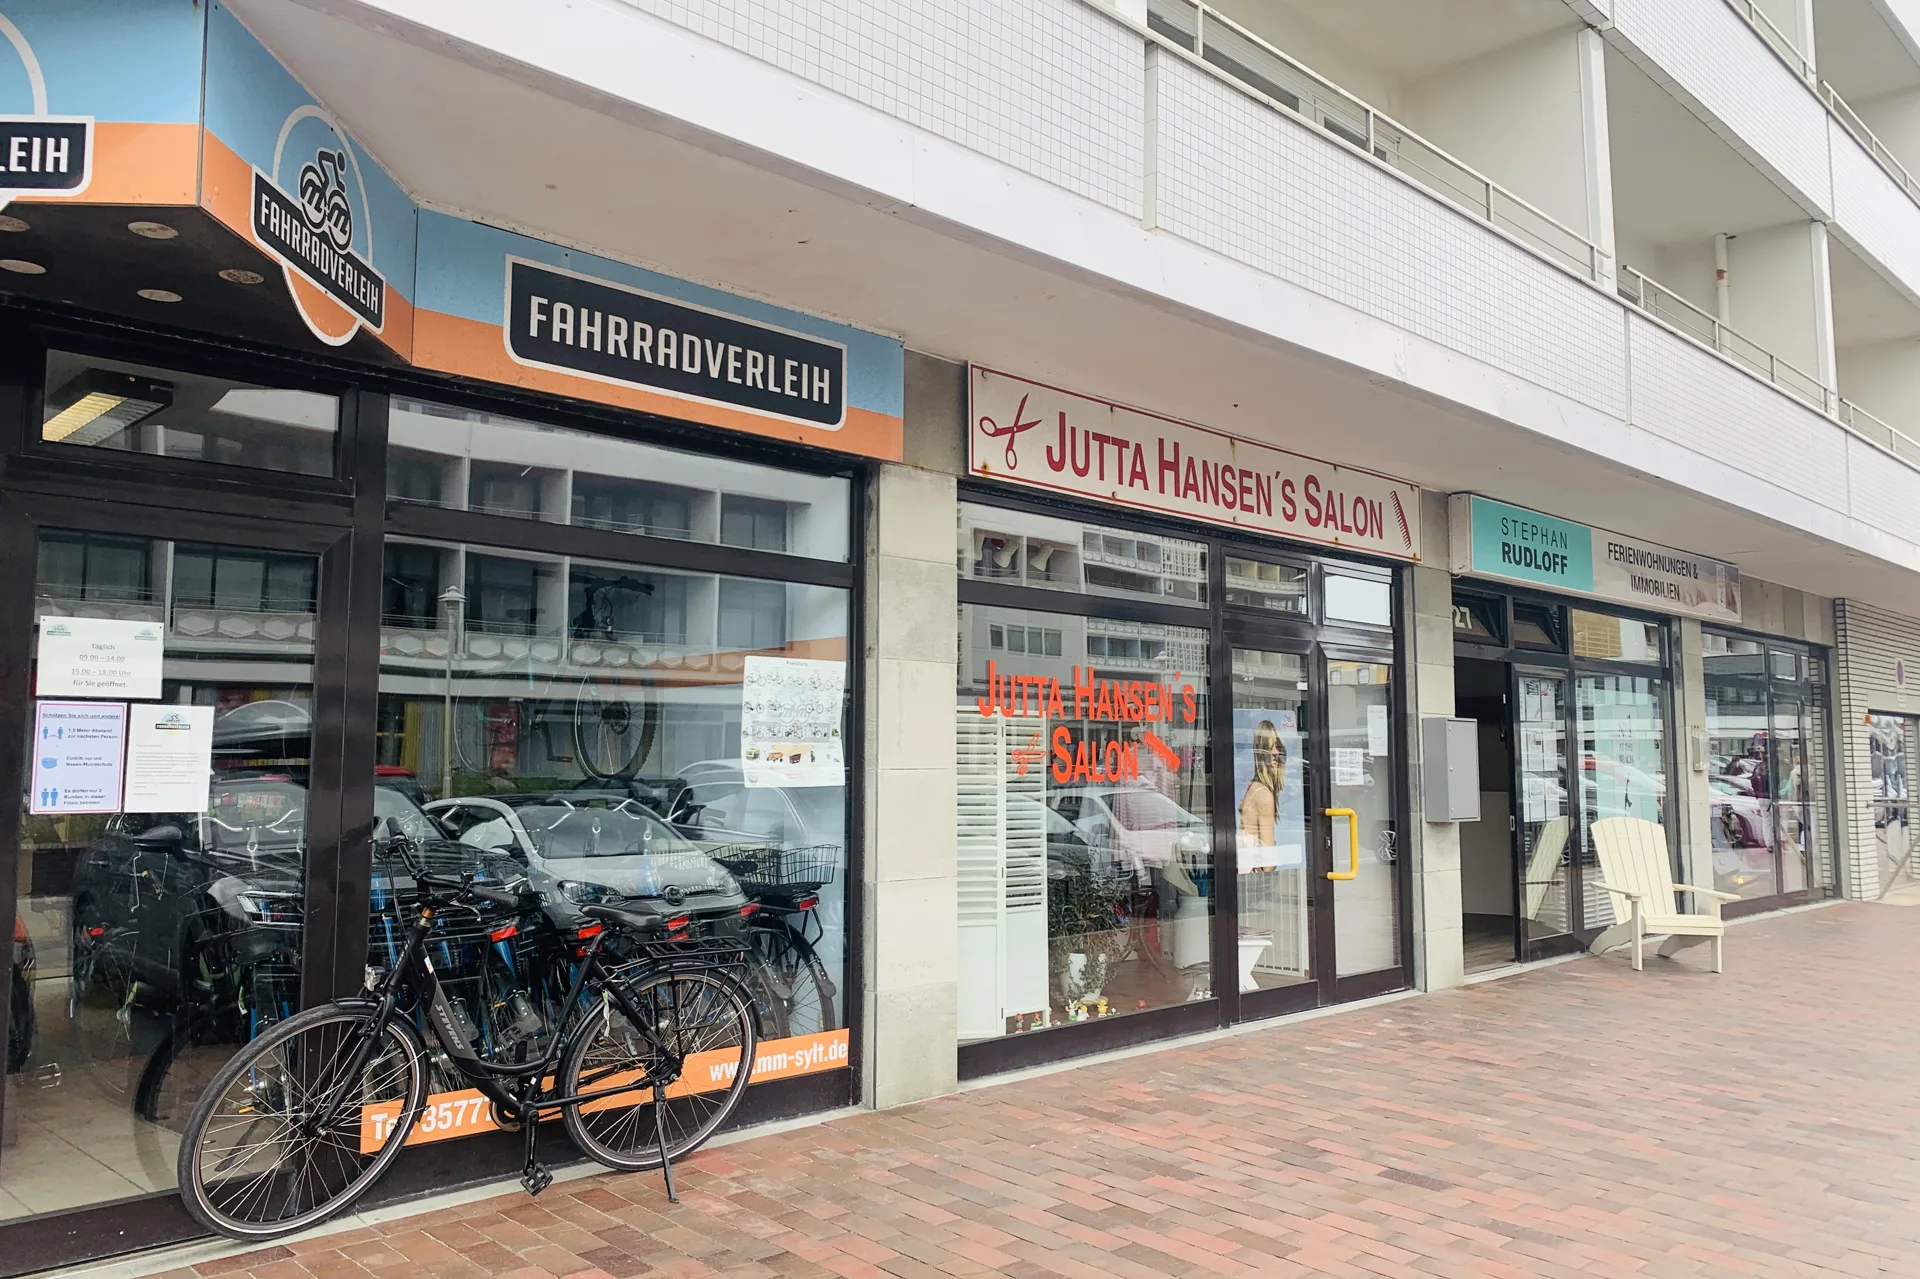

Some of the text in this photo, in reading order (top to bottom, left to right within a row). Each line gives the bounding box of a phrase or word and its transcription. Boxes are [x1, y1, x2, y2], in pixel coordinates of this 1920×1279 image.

[261, 192, 379, 315] FAHRRADVERLEIH
[529, 295, 830, 405] FAHRRADVERLEIH
[1046, 411, 1150, 491] JUTTA
[1304, 475, 1384, 540] SALON
[1501, 517, 1568, 549] STEPHAN
[1501, 542, 1568, 575] RUDLOFF
[1607, 542, 1699, 580] FERIENWOHNUNGEN &
[1630, 575, 1680, 601] IMMOBILIEN
[978, 659, 1064, 718] JUTTA
[1052, 725, 1138, 784] SALON
[435, 1004, 464, 1050] STEVENS
[709, 1039, 848, 1082] ww.mm-sylt.de
